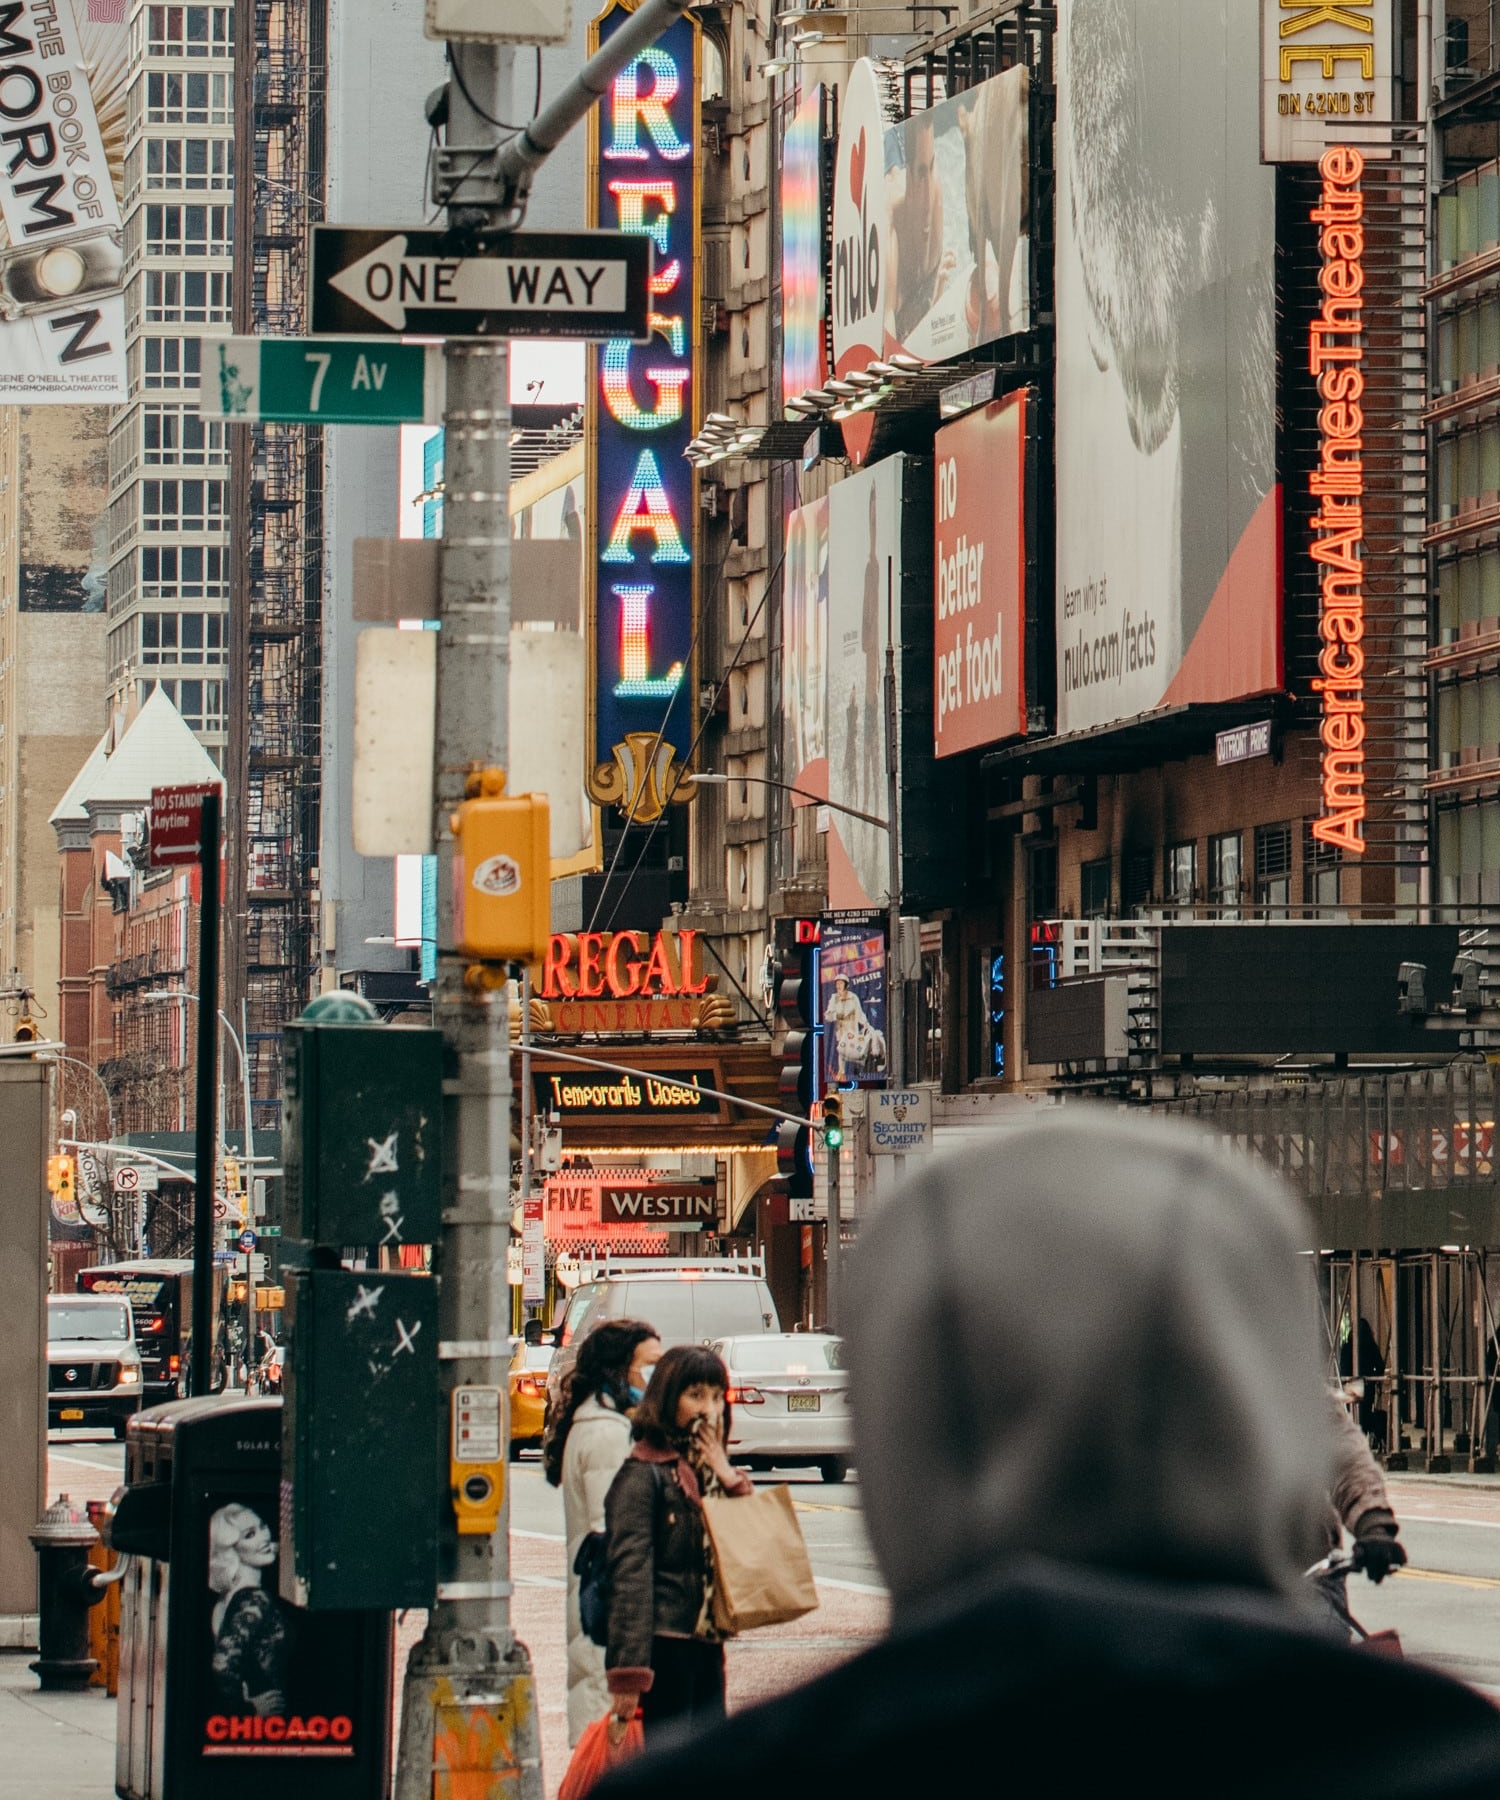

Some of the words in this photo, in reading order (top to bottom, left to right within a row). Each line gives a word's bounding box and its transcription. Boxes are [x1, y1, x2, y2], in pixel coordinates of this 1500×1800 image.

[1278, 92, 1303, 114] ON
[1305, 92, 1350, 114] 42ND
[1353, 91, 1375, 114] ST
[47, 70, 91, 167] BOOK
[73, 173, 104, 220] OF
[836, 184, 879, 328] nulo
[365, 262, 458, 303] ONE
[506, 265, 607, 306] WAY
[69, 374, 118, 383] THEATRE
[304, 354, 329, 412] 7
[352, 356, 389, 392] Av
[602, 46, 692, 697] REGAL
[938, 457, 957, 523] no
[938, 535, 984, 621] better
[1063, 585, 1081, 619] learn
[1083, 575, 1097, 616] why
[1099, 572, 1107, 605] at
[1064, 608, 1156, 692] nulo.com/facts
[938, 633, 962, 732] pet
[966, 612, 1003, 704] food
[1250, 726, 1269, 753] PRIME
[154, 796, 166, 809] NO
[154, 814, 190, 831] Anytime
[541, 929, 709, 998] REGAL
[559, 1003, 692, 1030] CINEMAS
[550, 1074, 641, 1107] Temporarily
[646, 1074, 700, 1106] Closed
[880, 1094, 920, 1106] NYPD
[547, 1187, 593, 1212] FIVE
[92, 1281, 165, 1292] GOLDEN
[205, 1714, 354, 1741] CHICAGO
